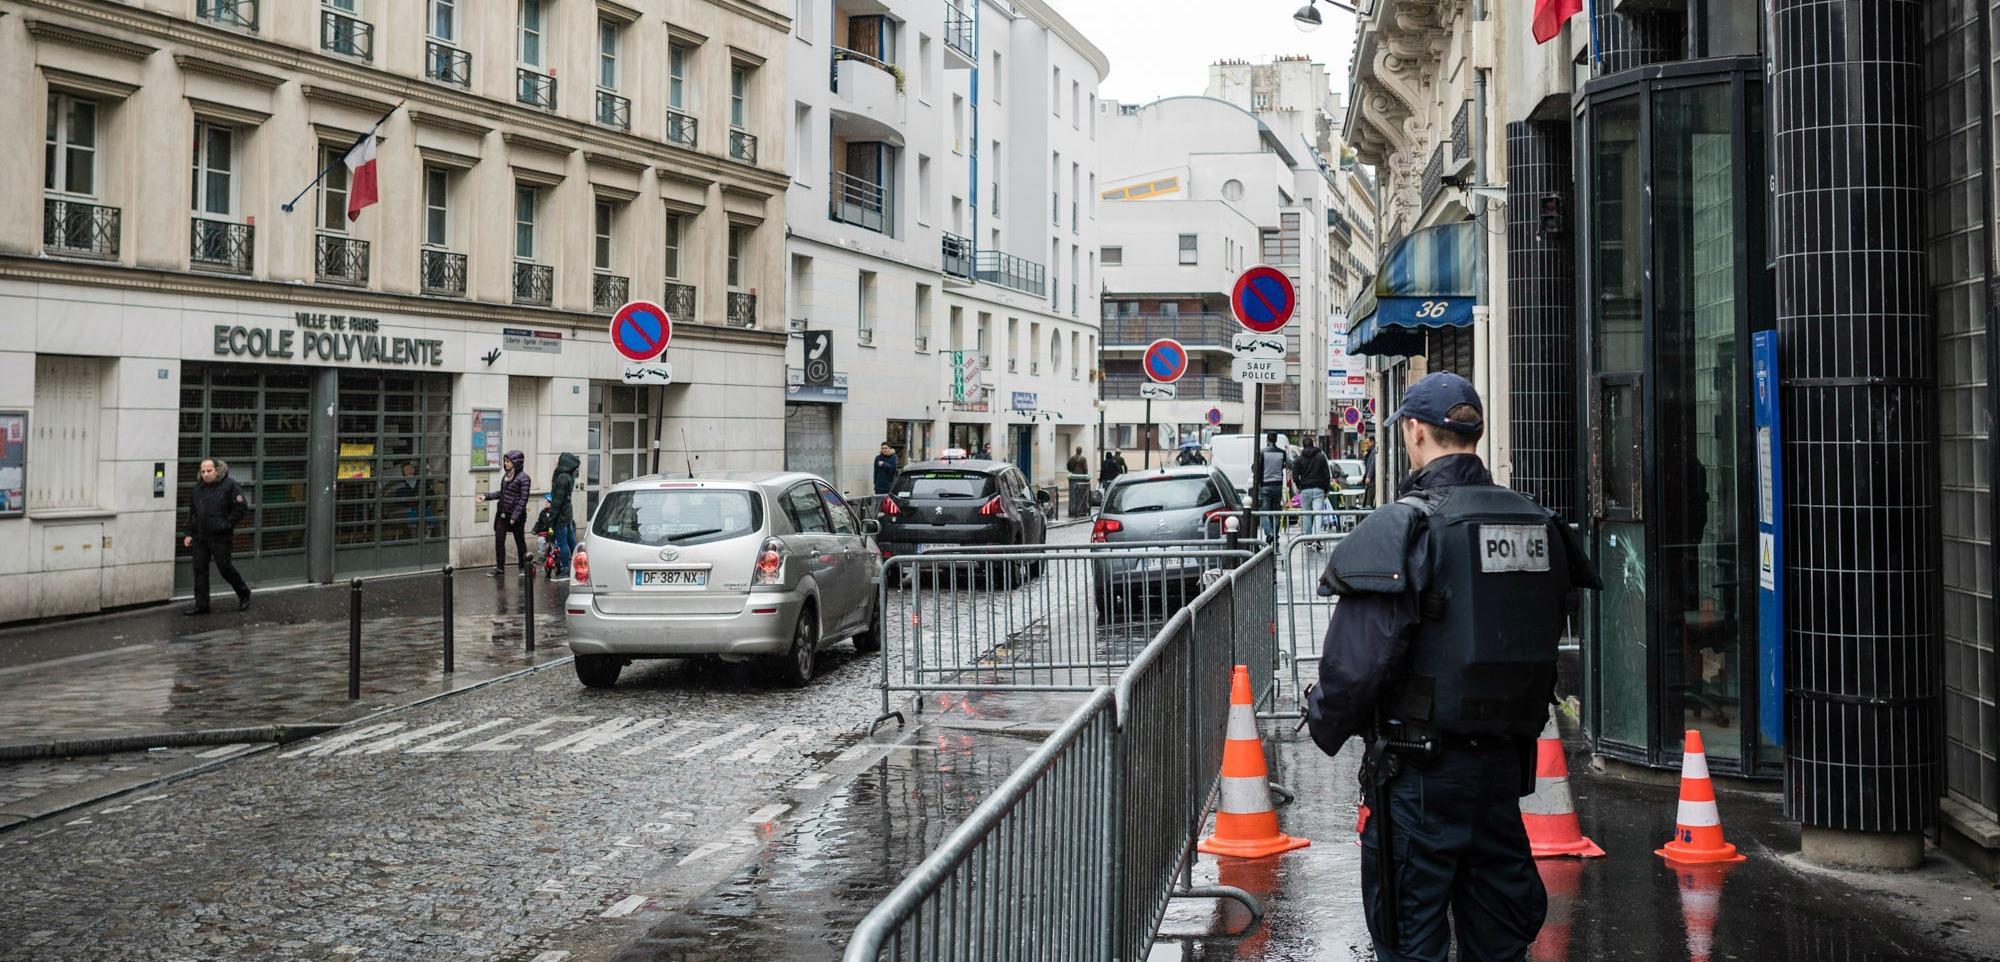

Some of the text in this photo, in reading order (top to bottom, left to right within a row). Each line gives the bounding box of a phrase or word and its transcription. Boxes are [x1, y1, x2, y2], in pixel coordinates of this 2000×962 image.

[1416, 301, 1449, 318] 36
[295, 312, 380, 333] VILLE DE PARIS
[214, 324, 444, 366] ECOLE POLYVALENTE
[1247, 362, 1271, 370] SAUF
[1242, 371, 1276, 380] POLICE
